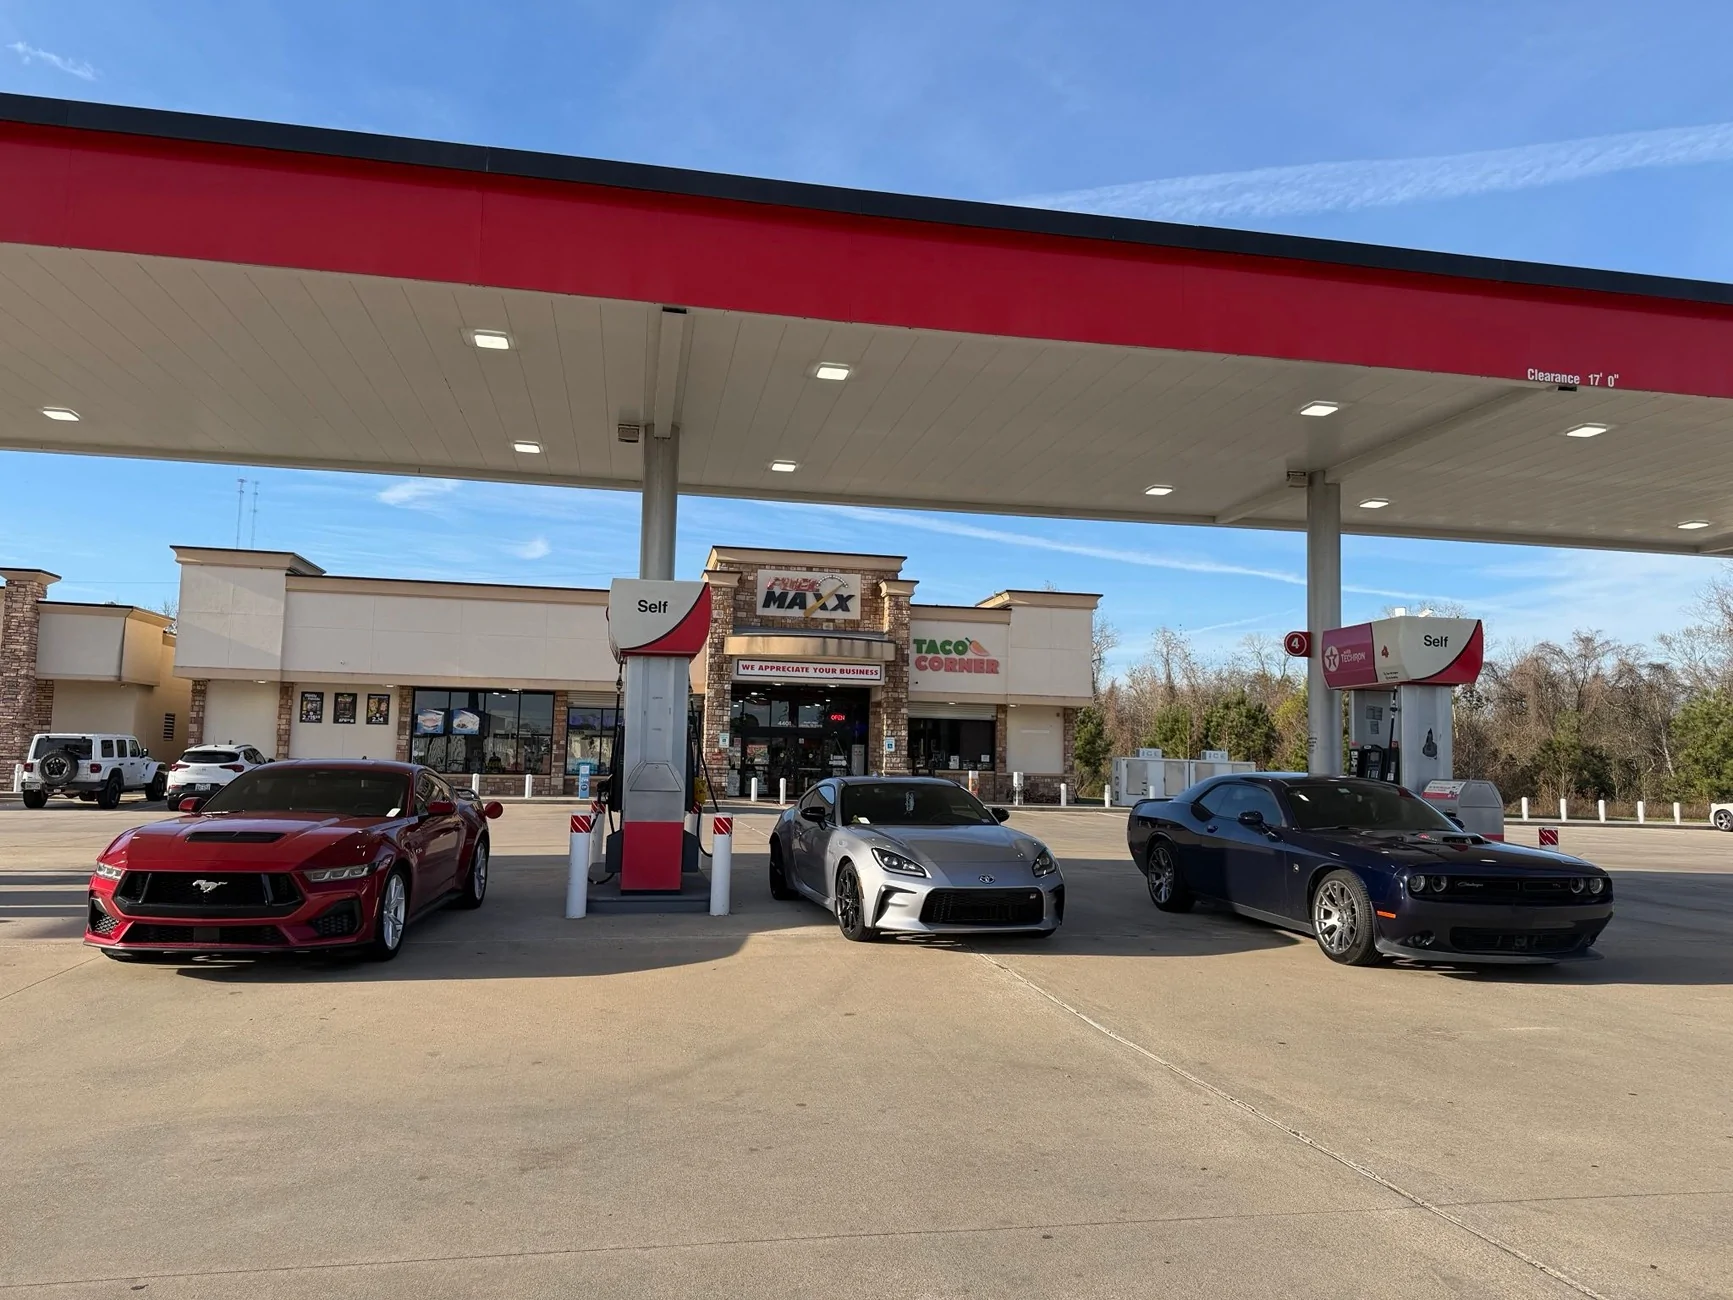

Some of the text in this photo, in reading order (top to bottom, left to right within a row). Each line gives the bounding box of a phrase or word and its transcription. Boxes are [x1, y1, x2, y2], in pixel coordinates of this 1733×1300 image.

[1527, 368, 1580, 384] Clearance
[1588, 372, 1603, 386] 17'
[637, 599, 668, 613] Self
[762, 590, 855, 612] MAXX
[913, 638, 969, 656] TACO
[1291, 638, 1300, 649] 4
[1423, 634, 1449, 648] Self
[1340, 652, 1366, 663] TECHRON
[1381, 645, 1389, 658] 4
[758, 665, 810, 673] APPRECIATE
[839, 668, 879, 676] BUSINESS
[915, 655, 1000, 674] CORNER
